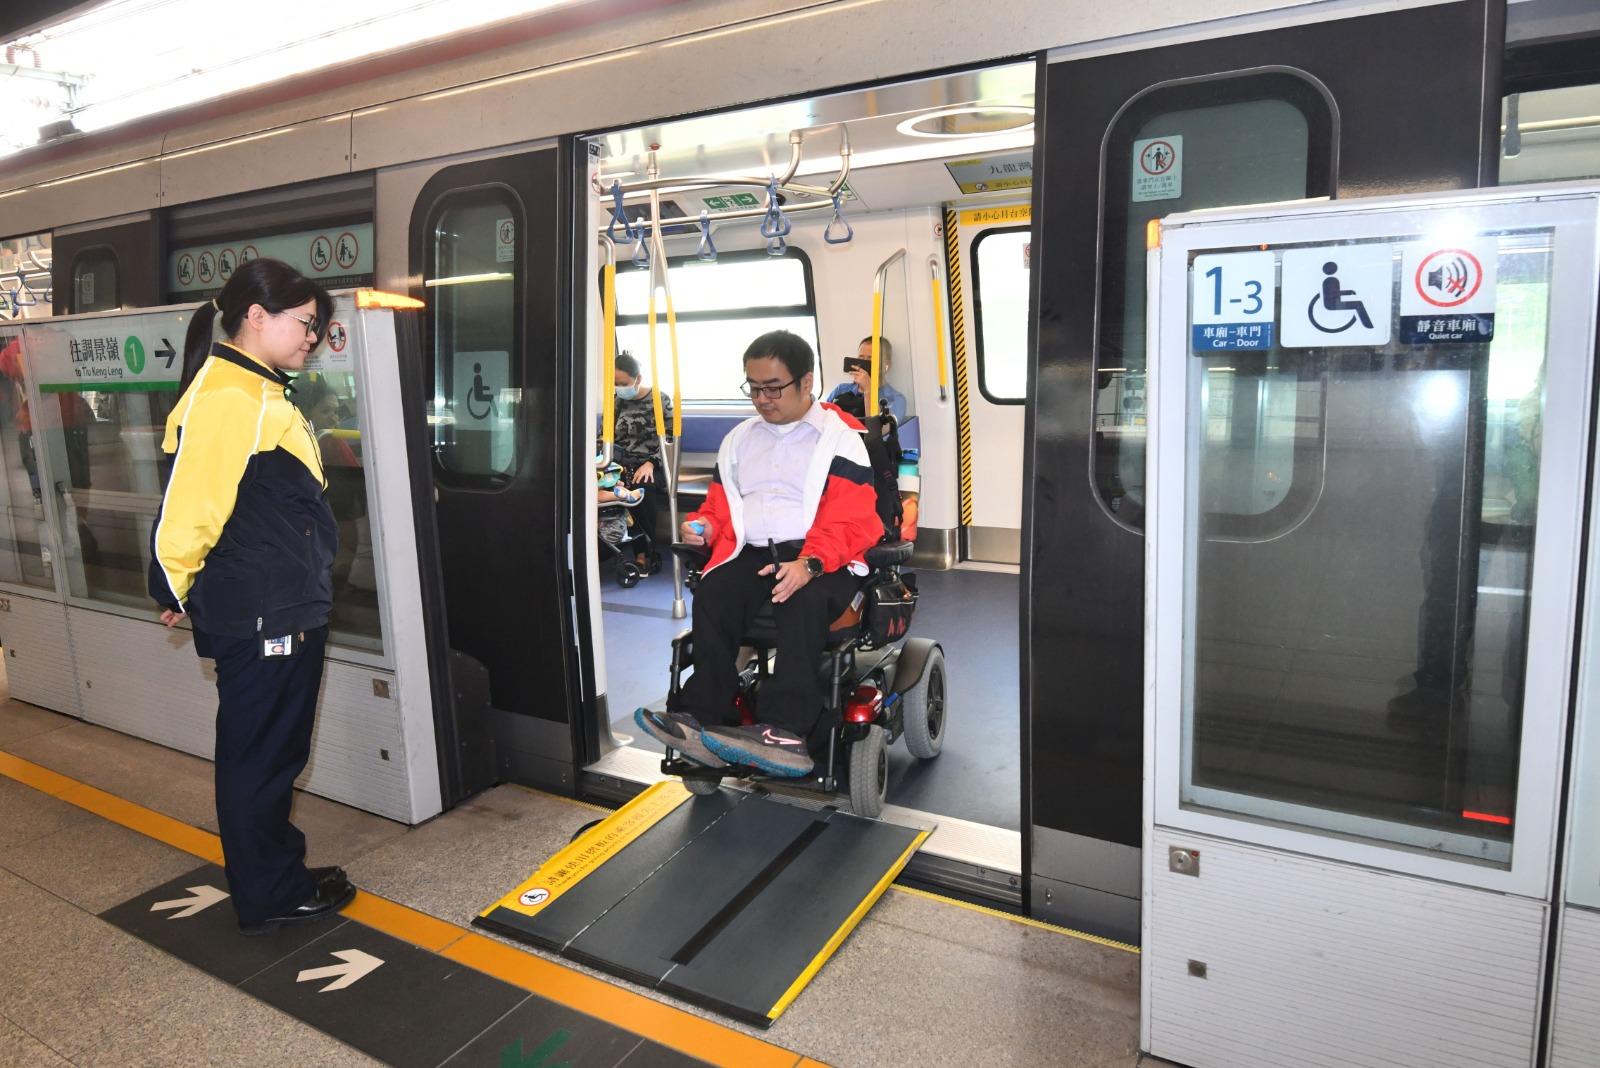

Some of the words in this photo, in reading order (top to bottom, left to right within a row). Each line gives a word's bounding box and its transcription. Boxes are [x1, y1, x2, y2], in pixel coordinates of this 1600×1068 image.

[1206, 266, 1263, 316] 1-3
[1416, 319, 1476, 333] 靜音車廂
[1212, 339, 1228, 348] Car
[1236, 338, 1259, 347] Door
[1428, 333, 1450, 341] Quiet
[70, 337, 120, 362] 往調景嶺
[130, 342, 138, 368] 1
[75, 368, 82, 377] to
[82, 366, 92, 377] Tiu
[92, 366, 107, 379] Keng
[107, 366, 123, 379] Leng
